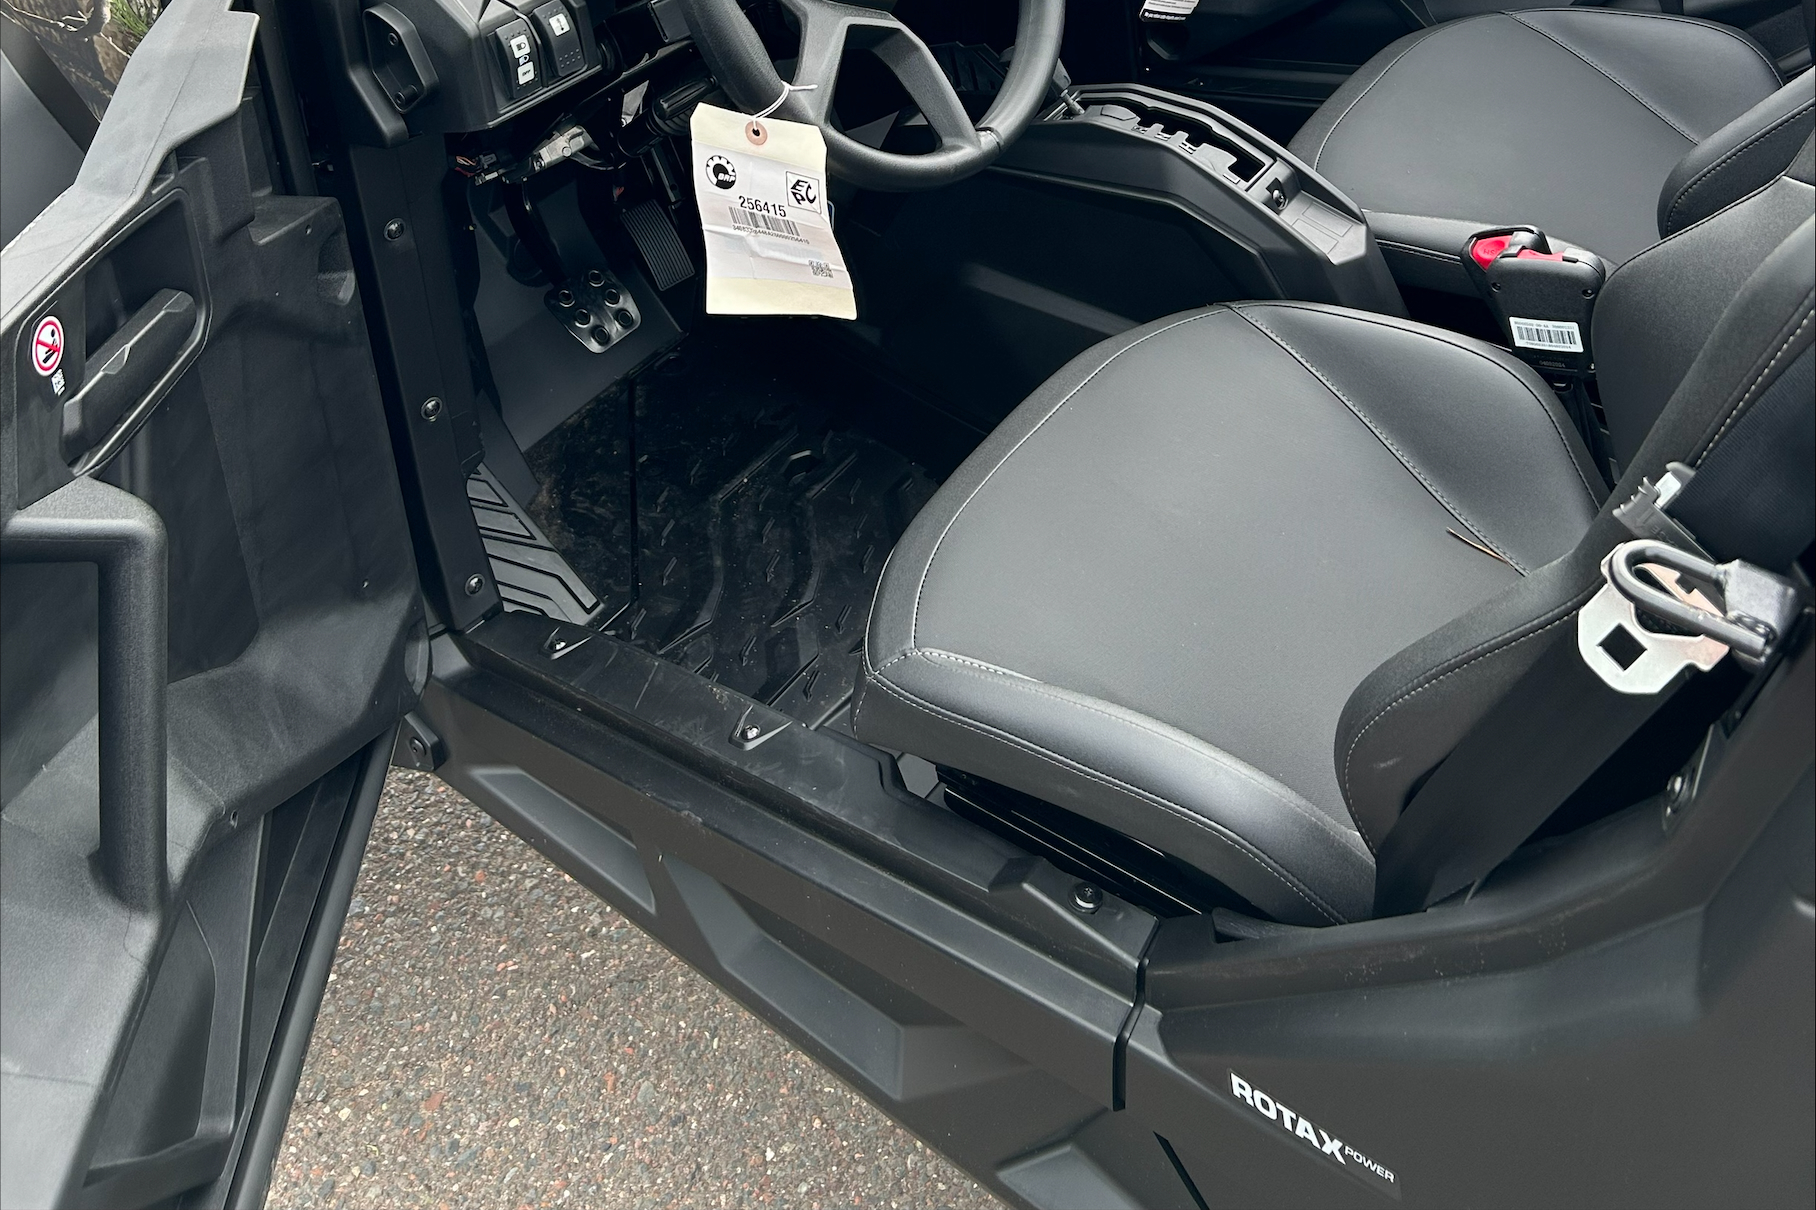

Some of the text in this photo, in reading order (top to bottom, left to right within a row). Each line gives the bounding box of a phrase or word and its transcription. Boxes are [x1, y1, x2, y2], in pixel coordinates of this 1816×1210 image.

[522, 69, 531, 77] OFF
[717, 172, 736, 182] BRP
[738, 195, 787, 218] 256415
[1230, 1072, 1395, 1183] ROTAX POWER
